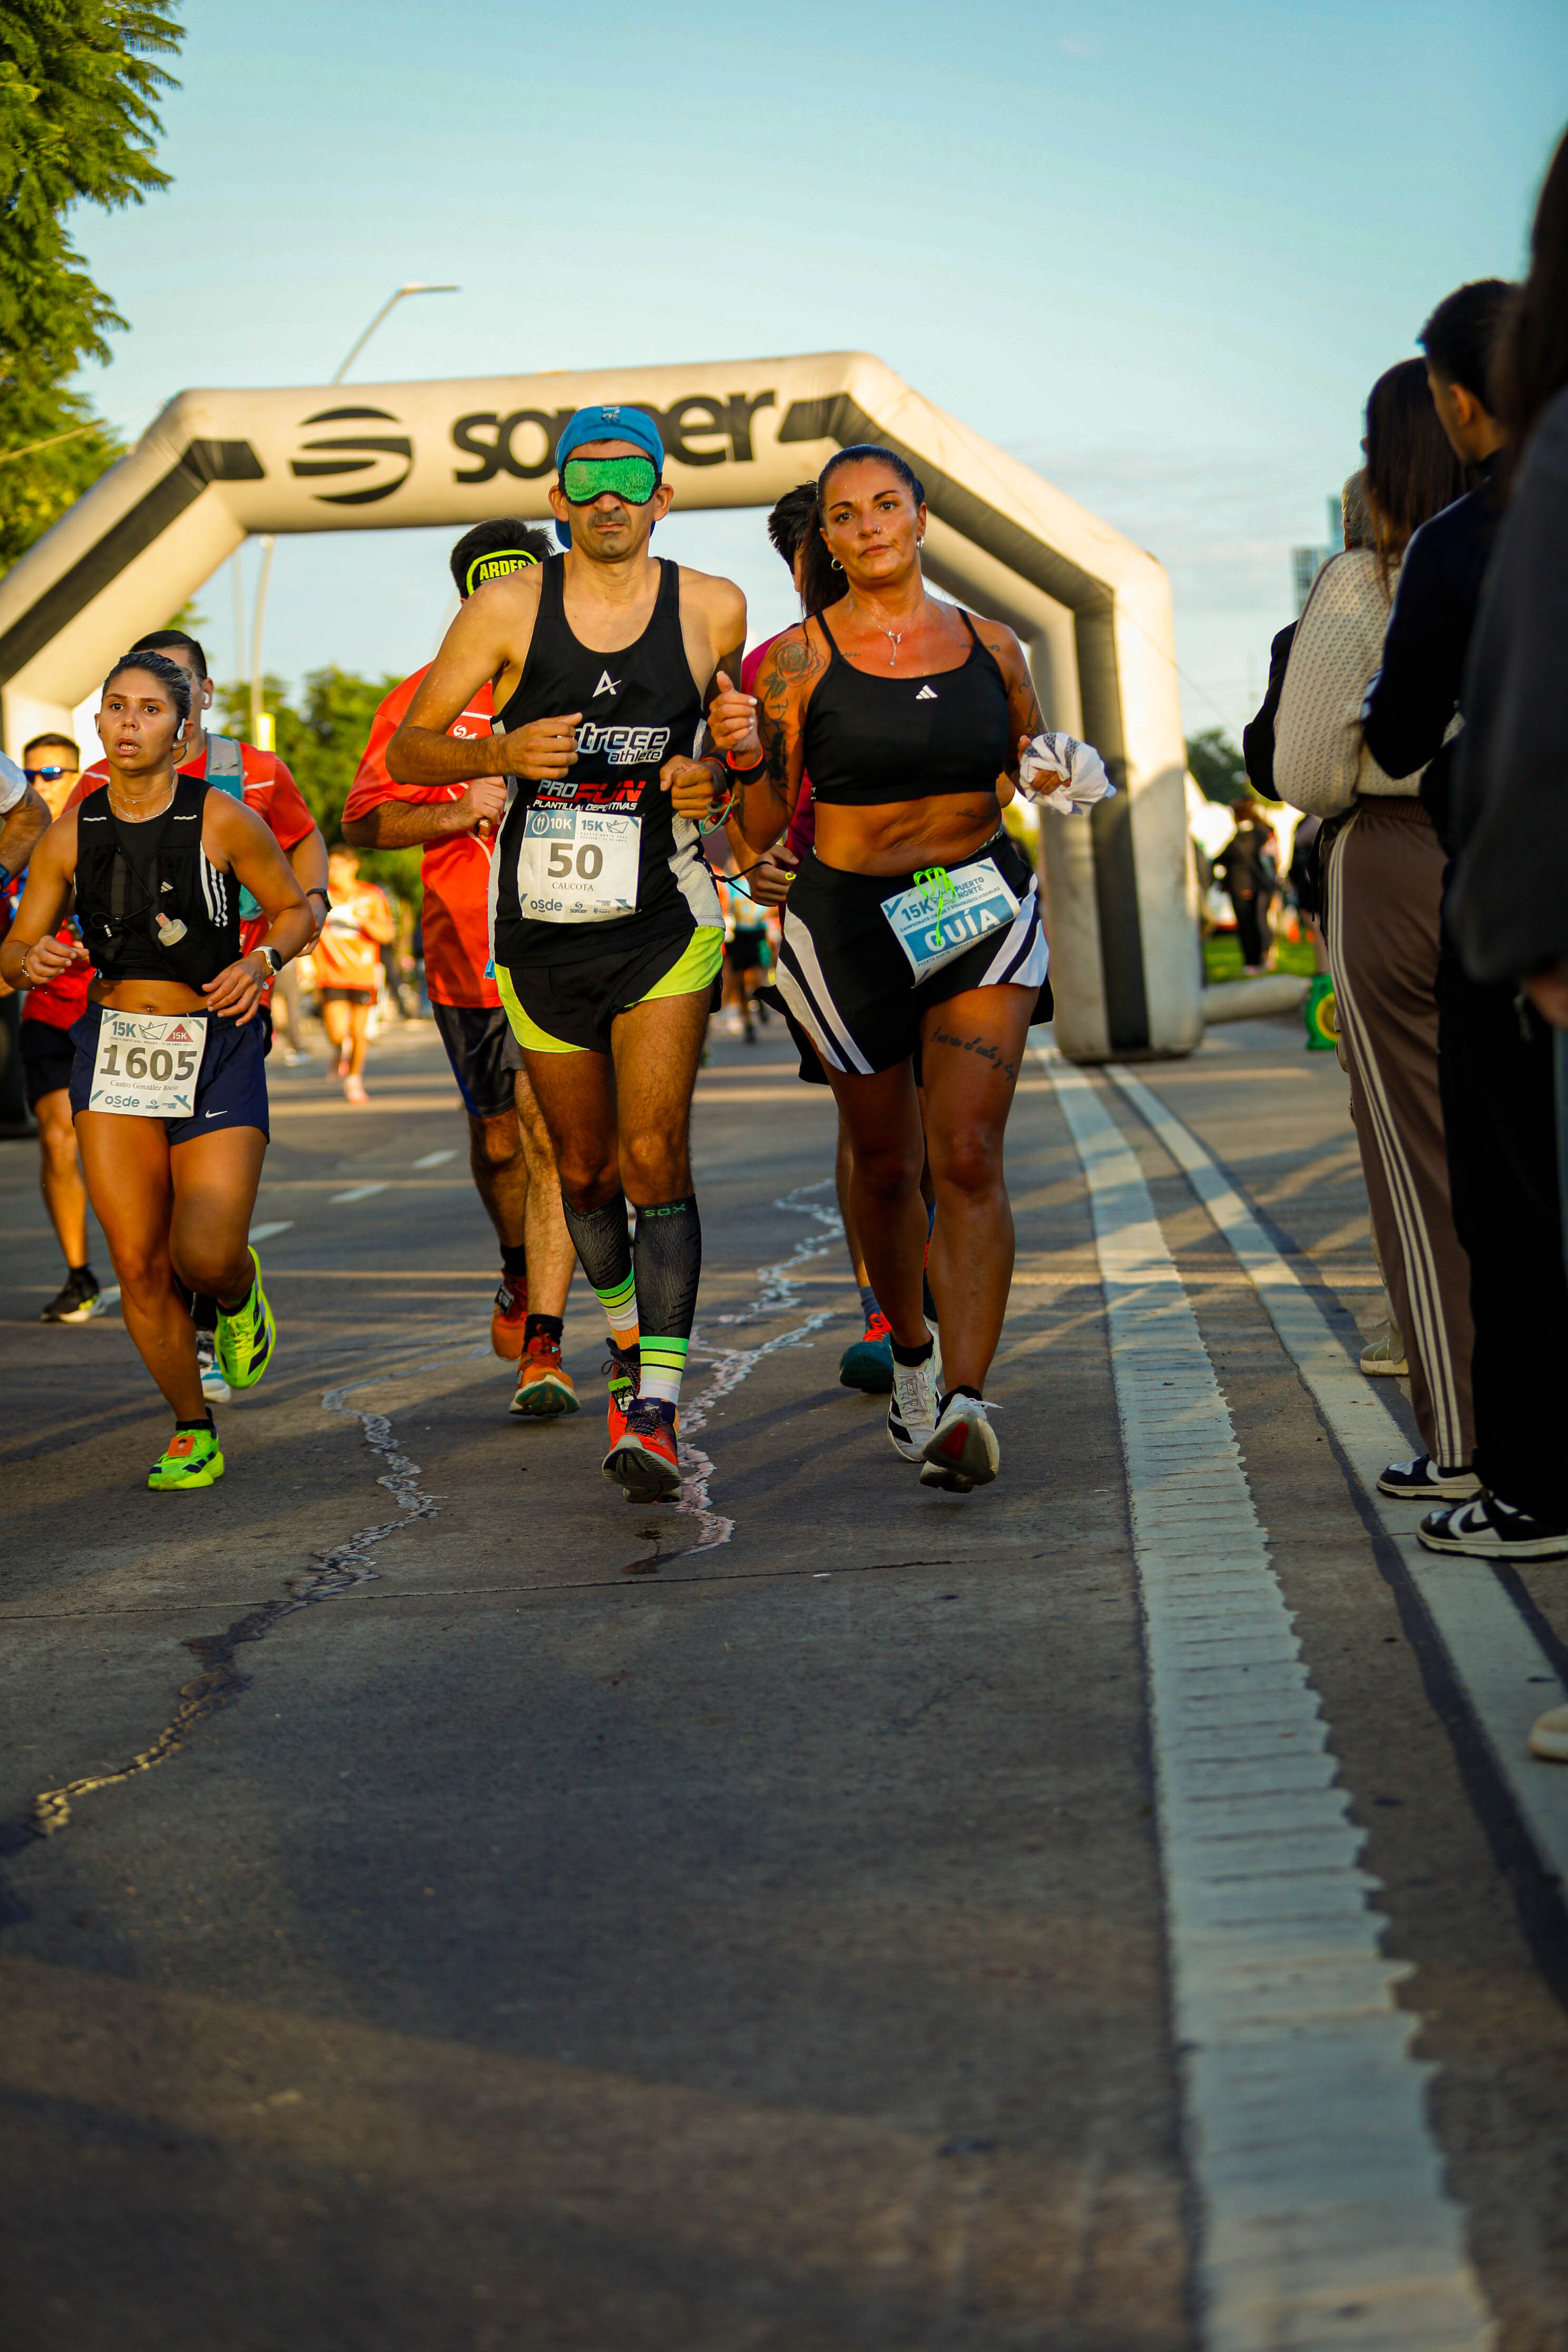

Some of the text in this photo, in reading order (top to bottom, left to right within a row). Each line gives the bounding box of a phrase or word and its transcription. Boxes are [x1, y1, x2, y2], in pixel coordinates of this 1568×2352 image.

[452, 390, 776, 483] soer
[607, 748, 663, 765] athlete
[551, 817, 572, 830] 10K
[581, 819, 604, 832] 15K
[547, 842, 603, 880] 50
[552, 882, 594, 891] CAUCOTA
[955, 876, 985, 892] PUERTO
[958, 885, 984, 899] NORTE
[530, 898, 563, 913] osde
[901, 897, 934, 922] 15K
[112, 1021, 136, 1038] 15K
[100, 1044, 198, 1082] 1605
[110, 1080, 131, 1088] Castro
[133, 1083, 161, 1091] González
[105, 1095, 140, 1108] osde
[645, 1203, 687, 1217] SOX
